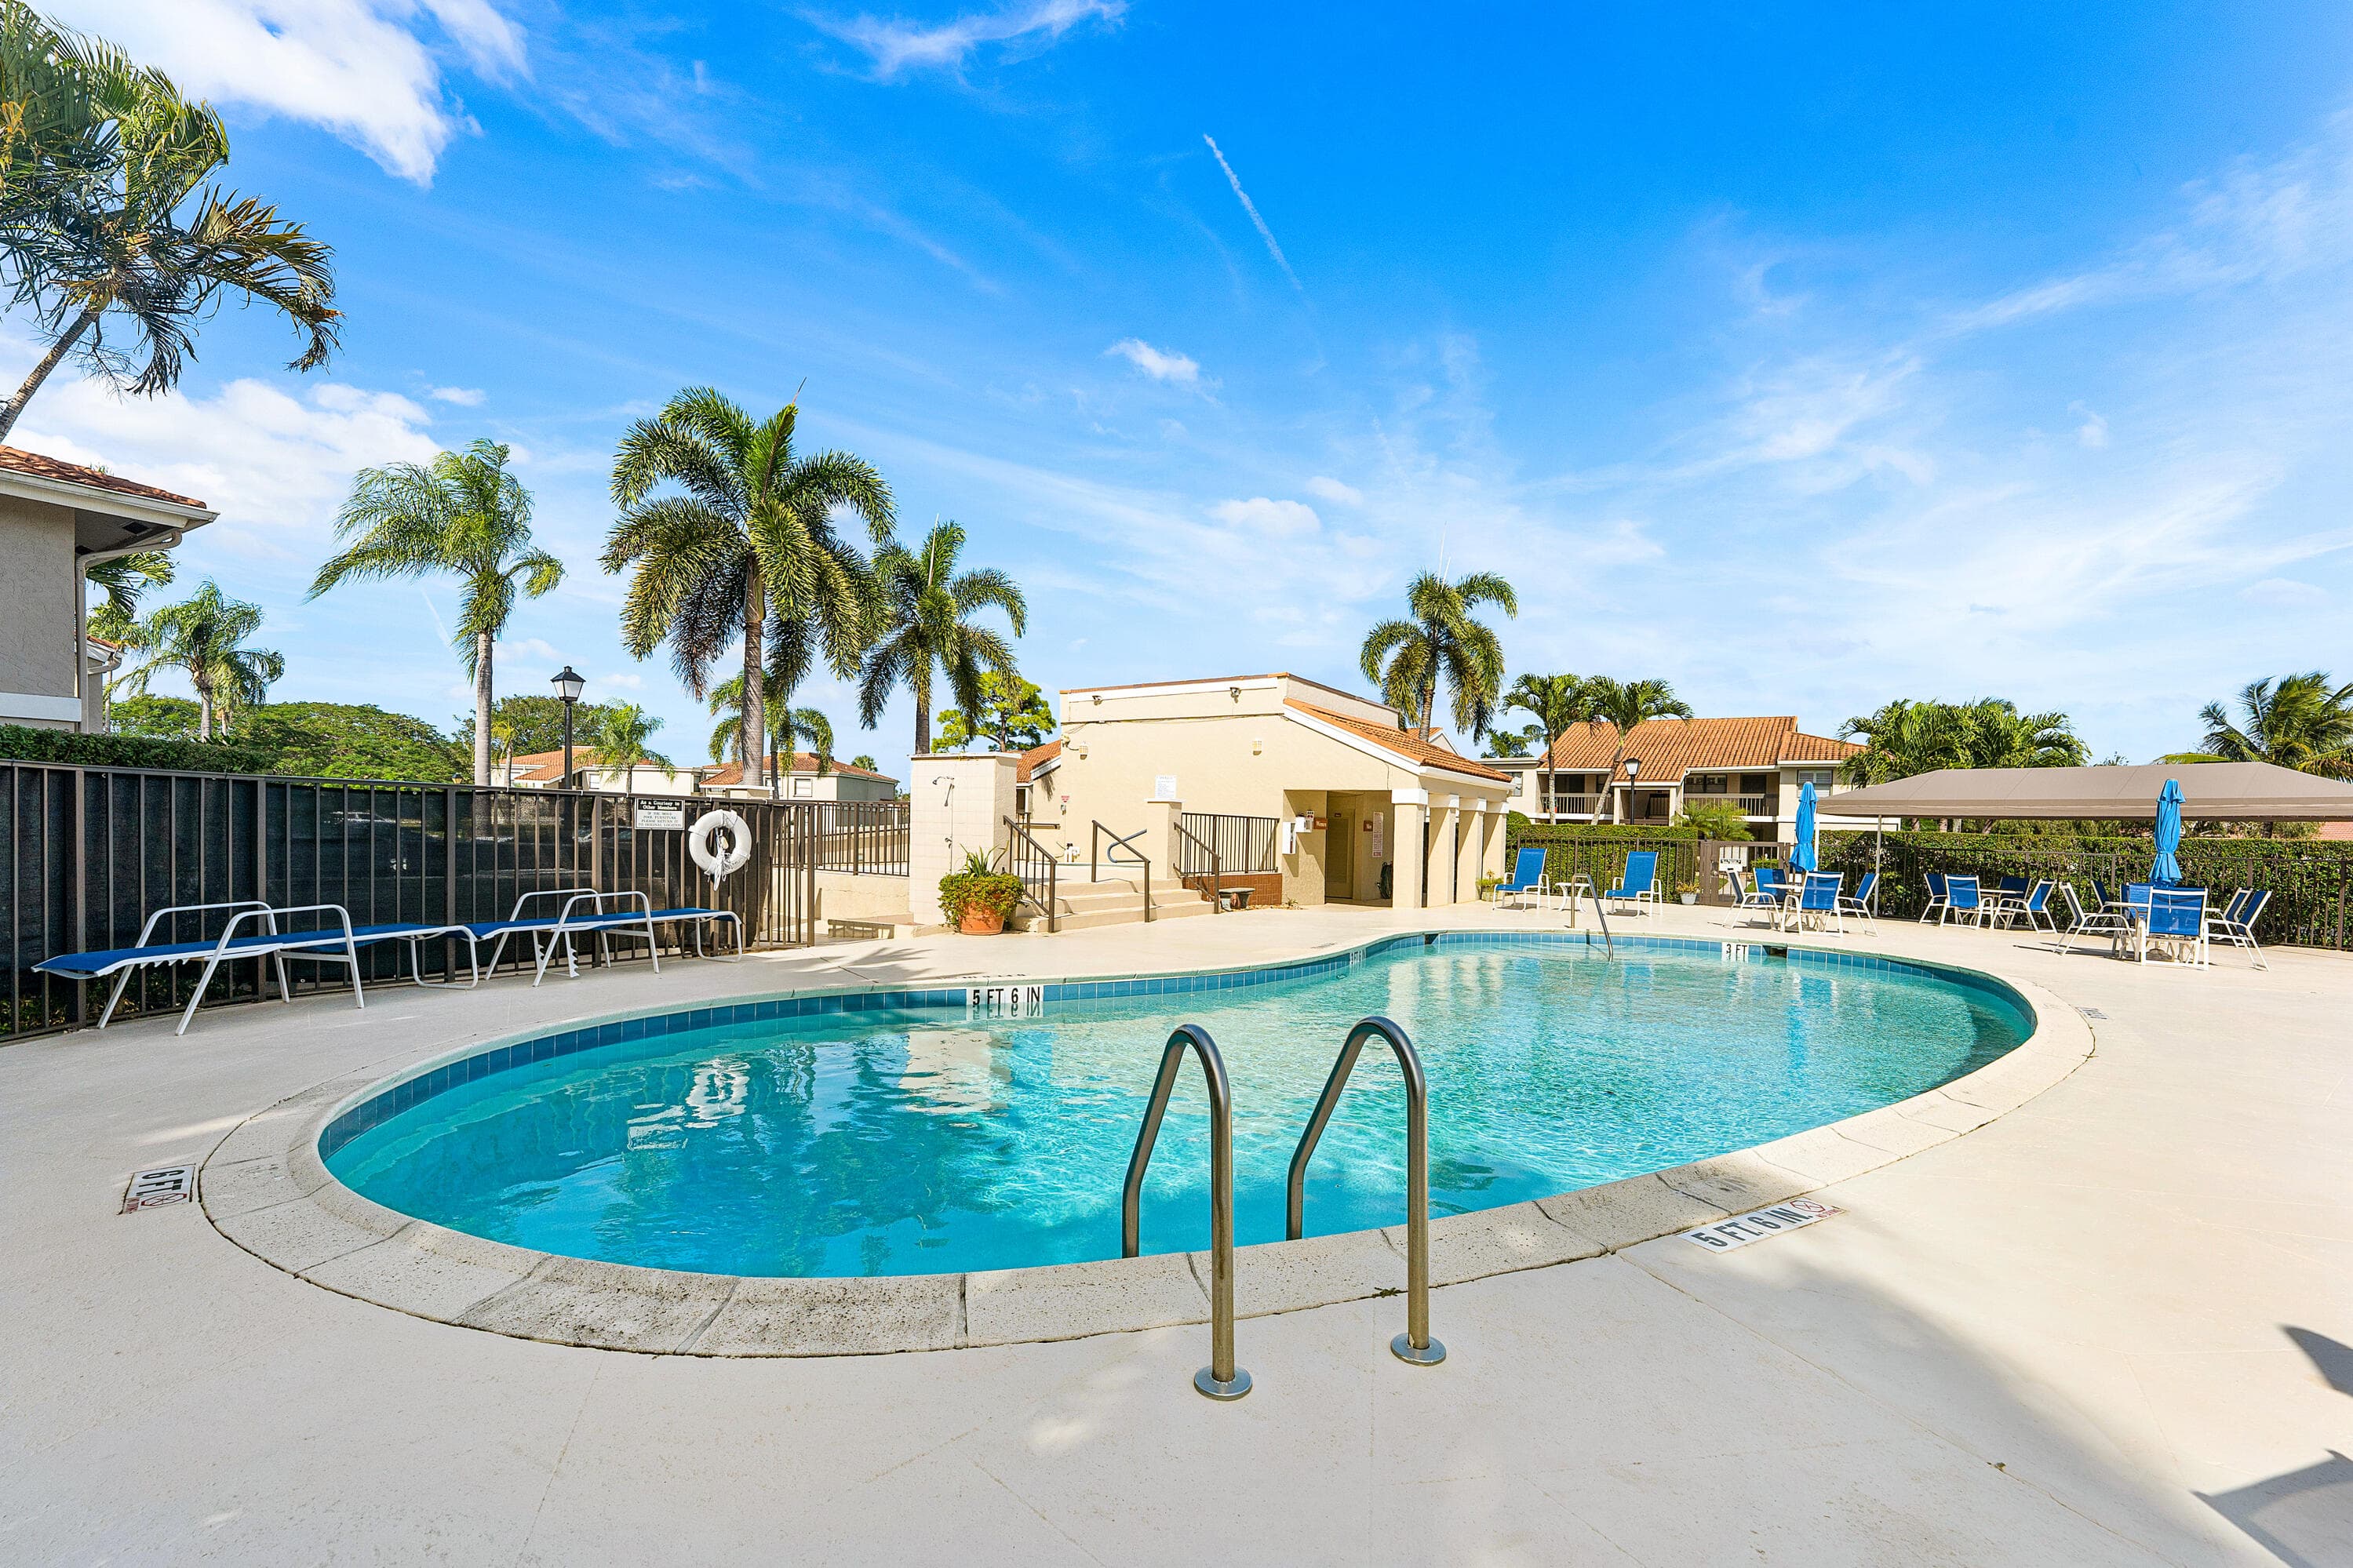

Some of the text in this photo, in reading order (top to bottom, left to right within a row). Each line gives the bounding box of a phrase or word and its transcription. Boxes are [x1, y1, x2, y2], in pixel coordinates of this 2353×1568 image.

[1726, 944, 1732, 954] 3
[973, 986, 1040, 1005] 5 FT 6 IN
[141, 1170, 185, 1179] 6
[1691, 1207, 1813, 1246] 5 FT. 6 IN.
